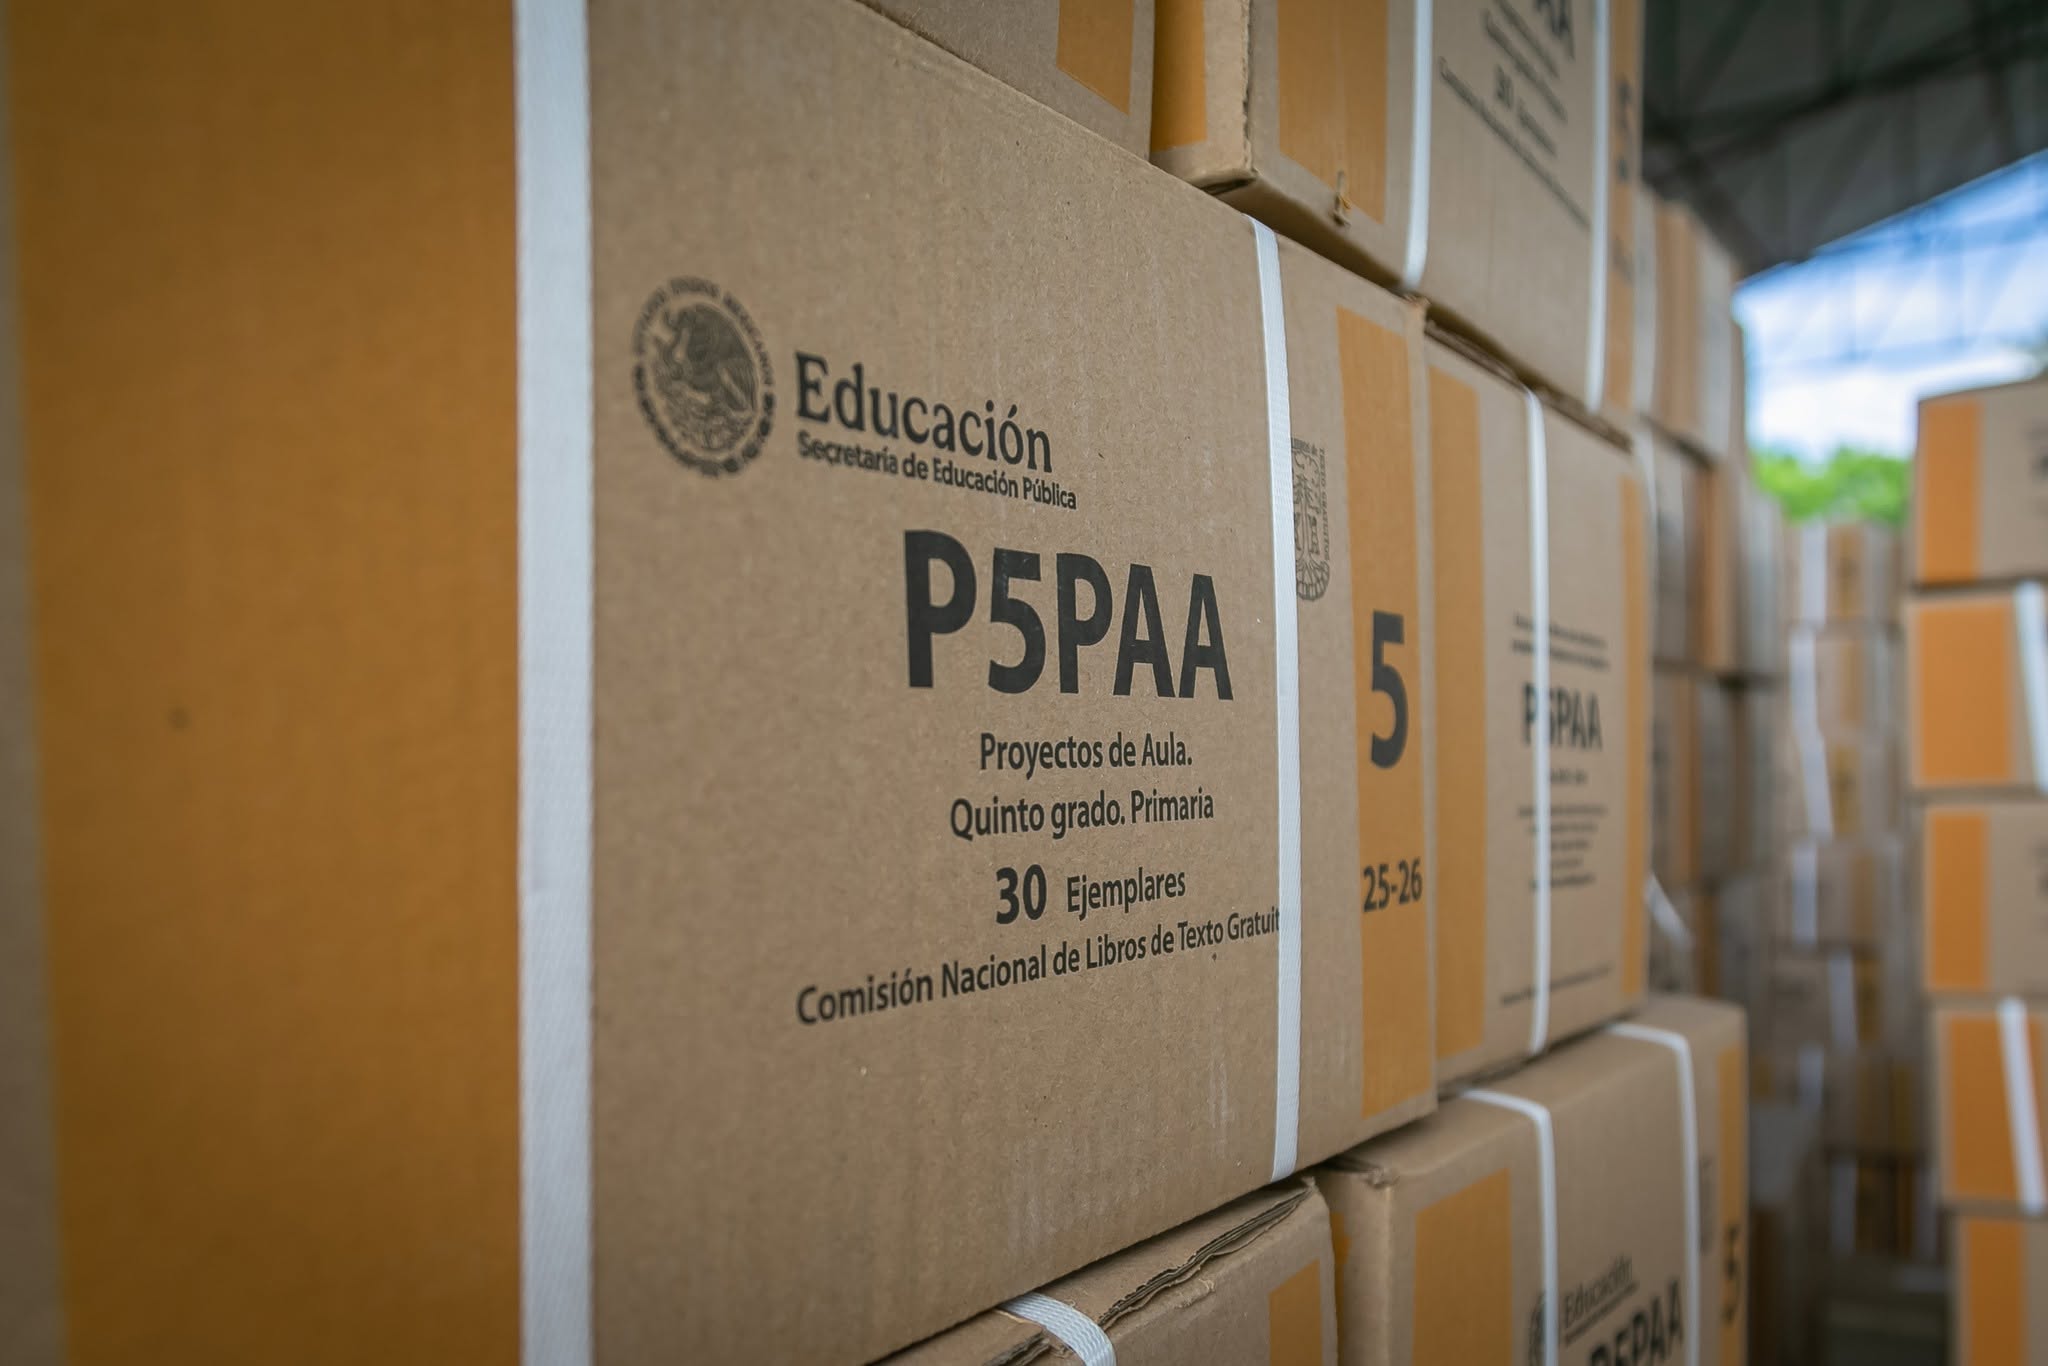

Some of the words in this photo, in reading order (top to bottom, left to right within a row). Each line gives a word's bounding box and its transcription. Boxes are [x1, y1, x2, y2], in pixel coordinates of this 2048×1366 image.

[795, 351, 1052, 474] Educación
[798, 430, 897, 477] Secretaría
[902, 452, 928, 480] de
[933, 456, 1018, 499] Educación
[1023, 476, 1077, 510] Pública
[904, 530, 1234, 701] P5PAA
[1370, 610, 1408, 769] 5
[980, 733, 1104, 780] Proyectos
[1108, 732, 1137, 768] de
[1142, 731, 1192, 766] Aula.
[950, 796, 1045, 841] Quinto
[1050, 789, 1126, 840] grado.
[1131, 785, 1214, 824] Primaria
[996, 864, 1048, 924] 30
[1066, 866, 1186, 922] Ejemplares
[1362, 859, 1423, 912] 25-26
[797, 967, 934, 1026] Comisión
[942, 943, 1047, 999] Nacional
[1052, 940, 1081, 976] de
[1086, 933, 1147, 970] Libros
[1151, 923, 1175, 957] de
[1178, 919, 1224, 951] Texto
[1228, 906, 1279, 940] Gratuit
